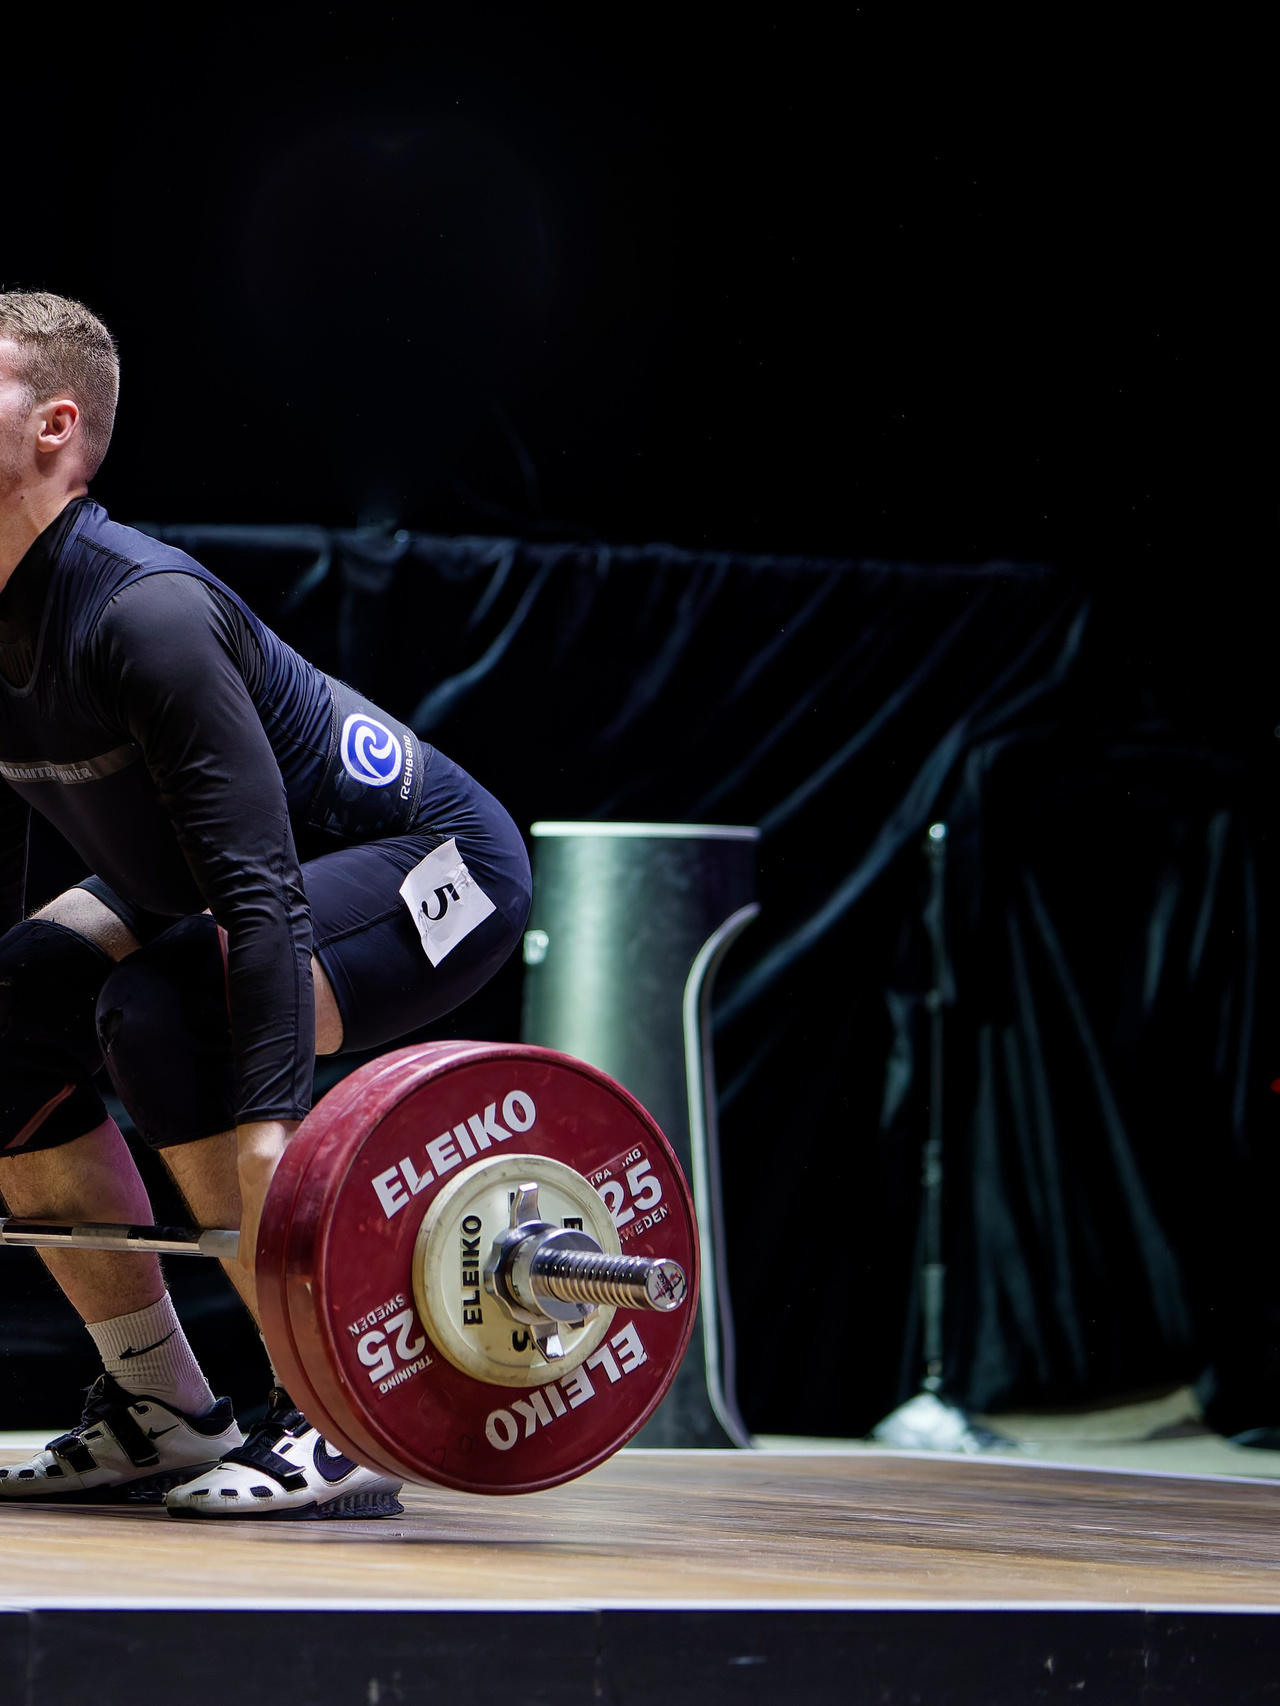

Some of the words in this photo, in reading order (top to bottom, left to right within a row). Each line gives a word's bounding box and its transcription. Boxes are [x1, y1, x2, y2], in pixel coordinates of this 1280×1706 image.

[423, 883, 461, 920] 5
[371, 1090, 536, 1220] ELEIKO
[597, 1159, 662, 1230] 25
[620, 1204, 672, 1246] WEDEN
[462, 1215, 483, 1326] ELEIKO
[348, 1294, 406, 1337] SWEDEN
[357, 1308, 426, 1383] 25
[379, 1355, 433, 1394] TRAINING
[485, 1320, 648, 1450] ELEIKO
